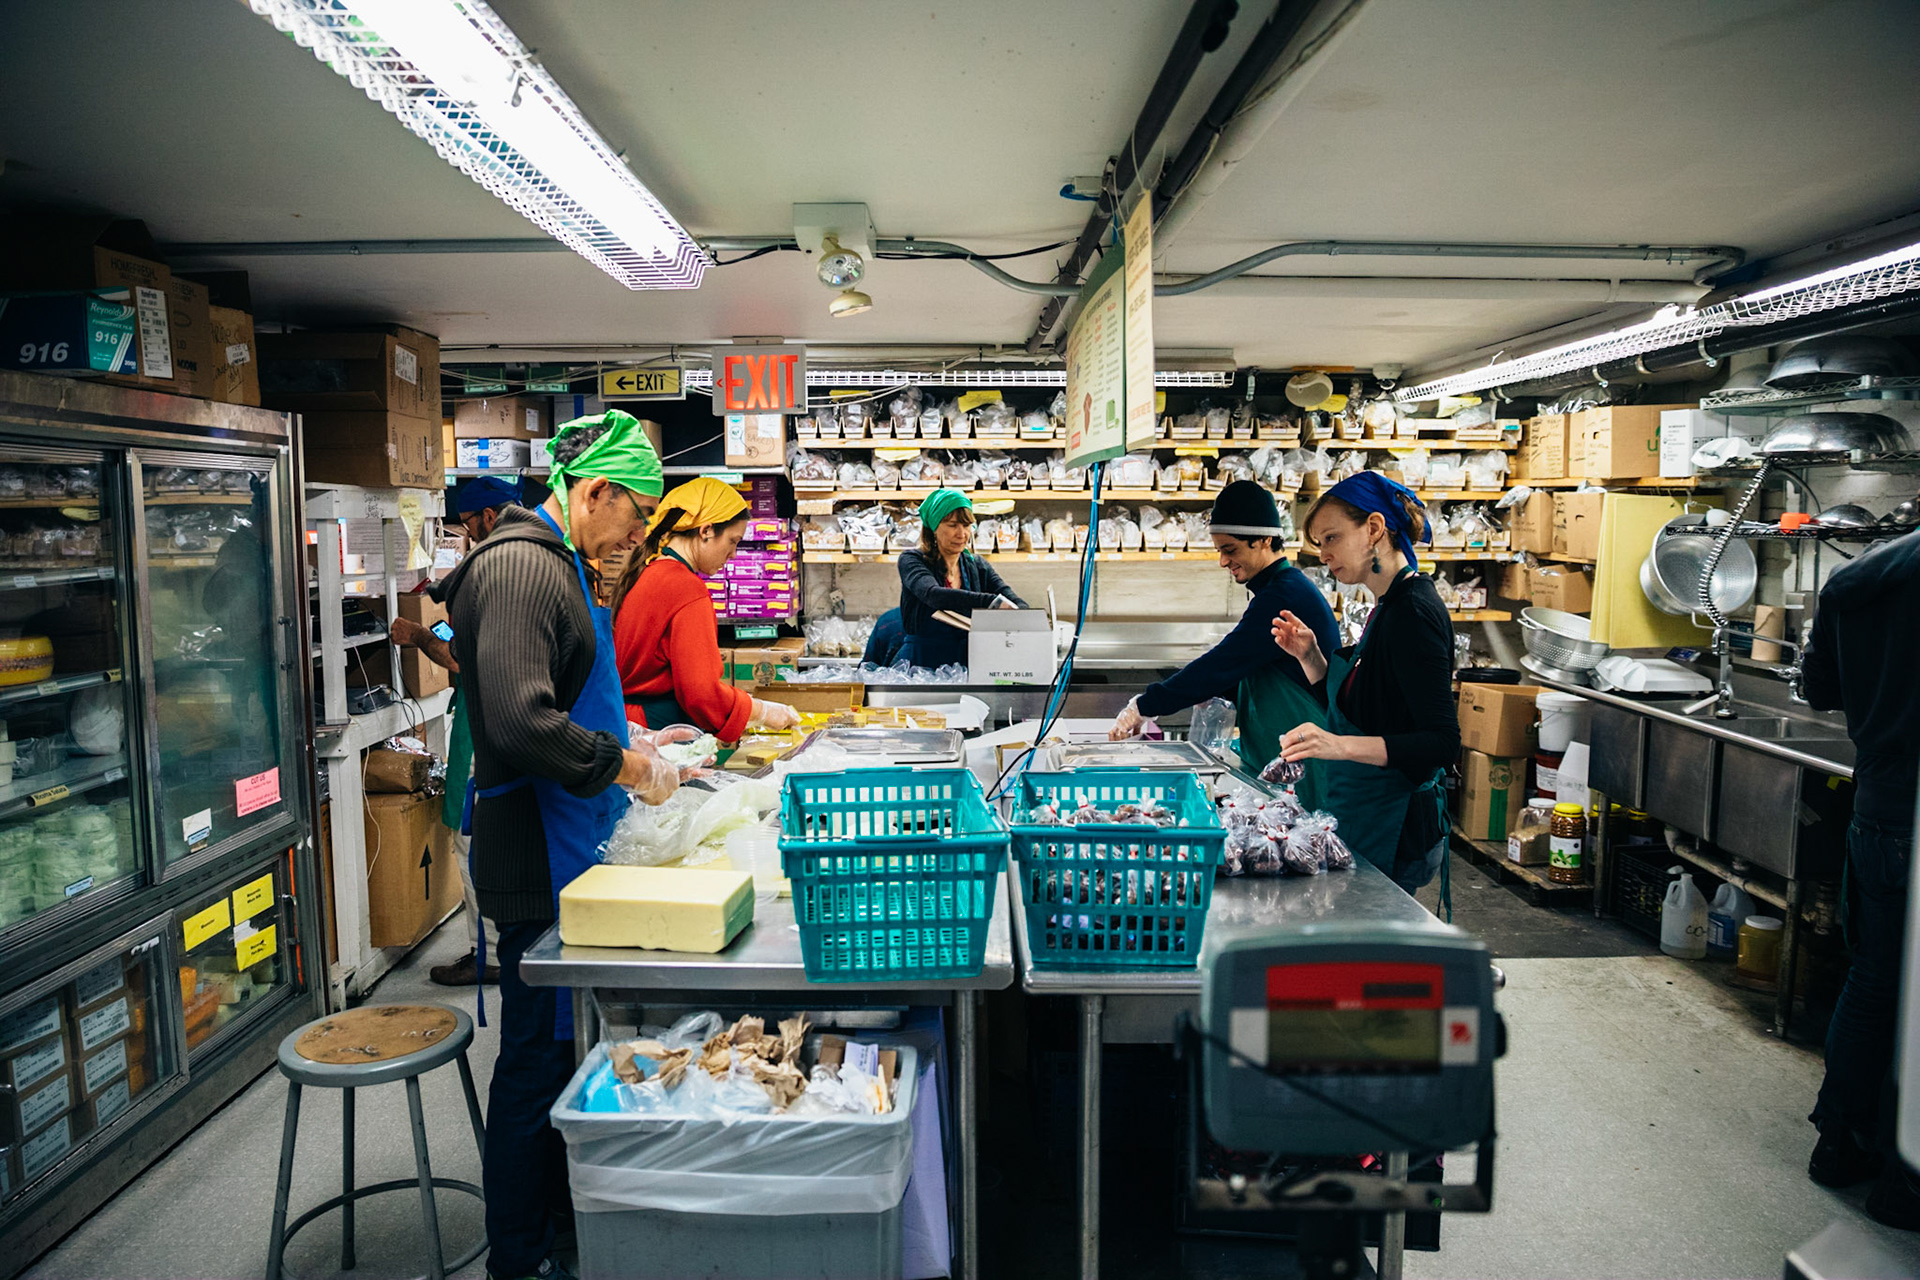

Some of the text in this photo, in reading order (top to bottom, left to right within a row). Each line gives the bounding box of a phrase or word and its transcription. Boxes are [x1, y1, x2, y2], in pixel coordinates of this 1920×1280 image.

[90, 302, 123, 316] Reynolds
[95, 331, 118, 345] 916
[19, 341, 69, 365] 916
[636, 373, 666, 391] EXIT
[725, 354, 798, 410] EXIT
